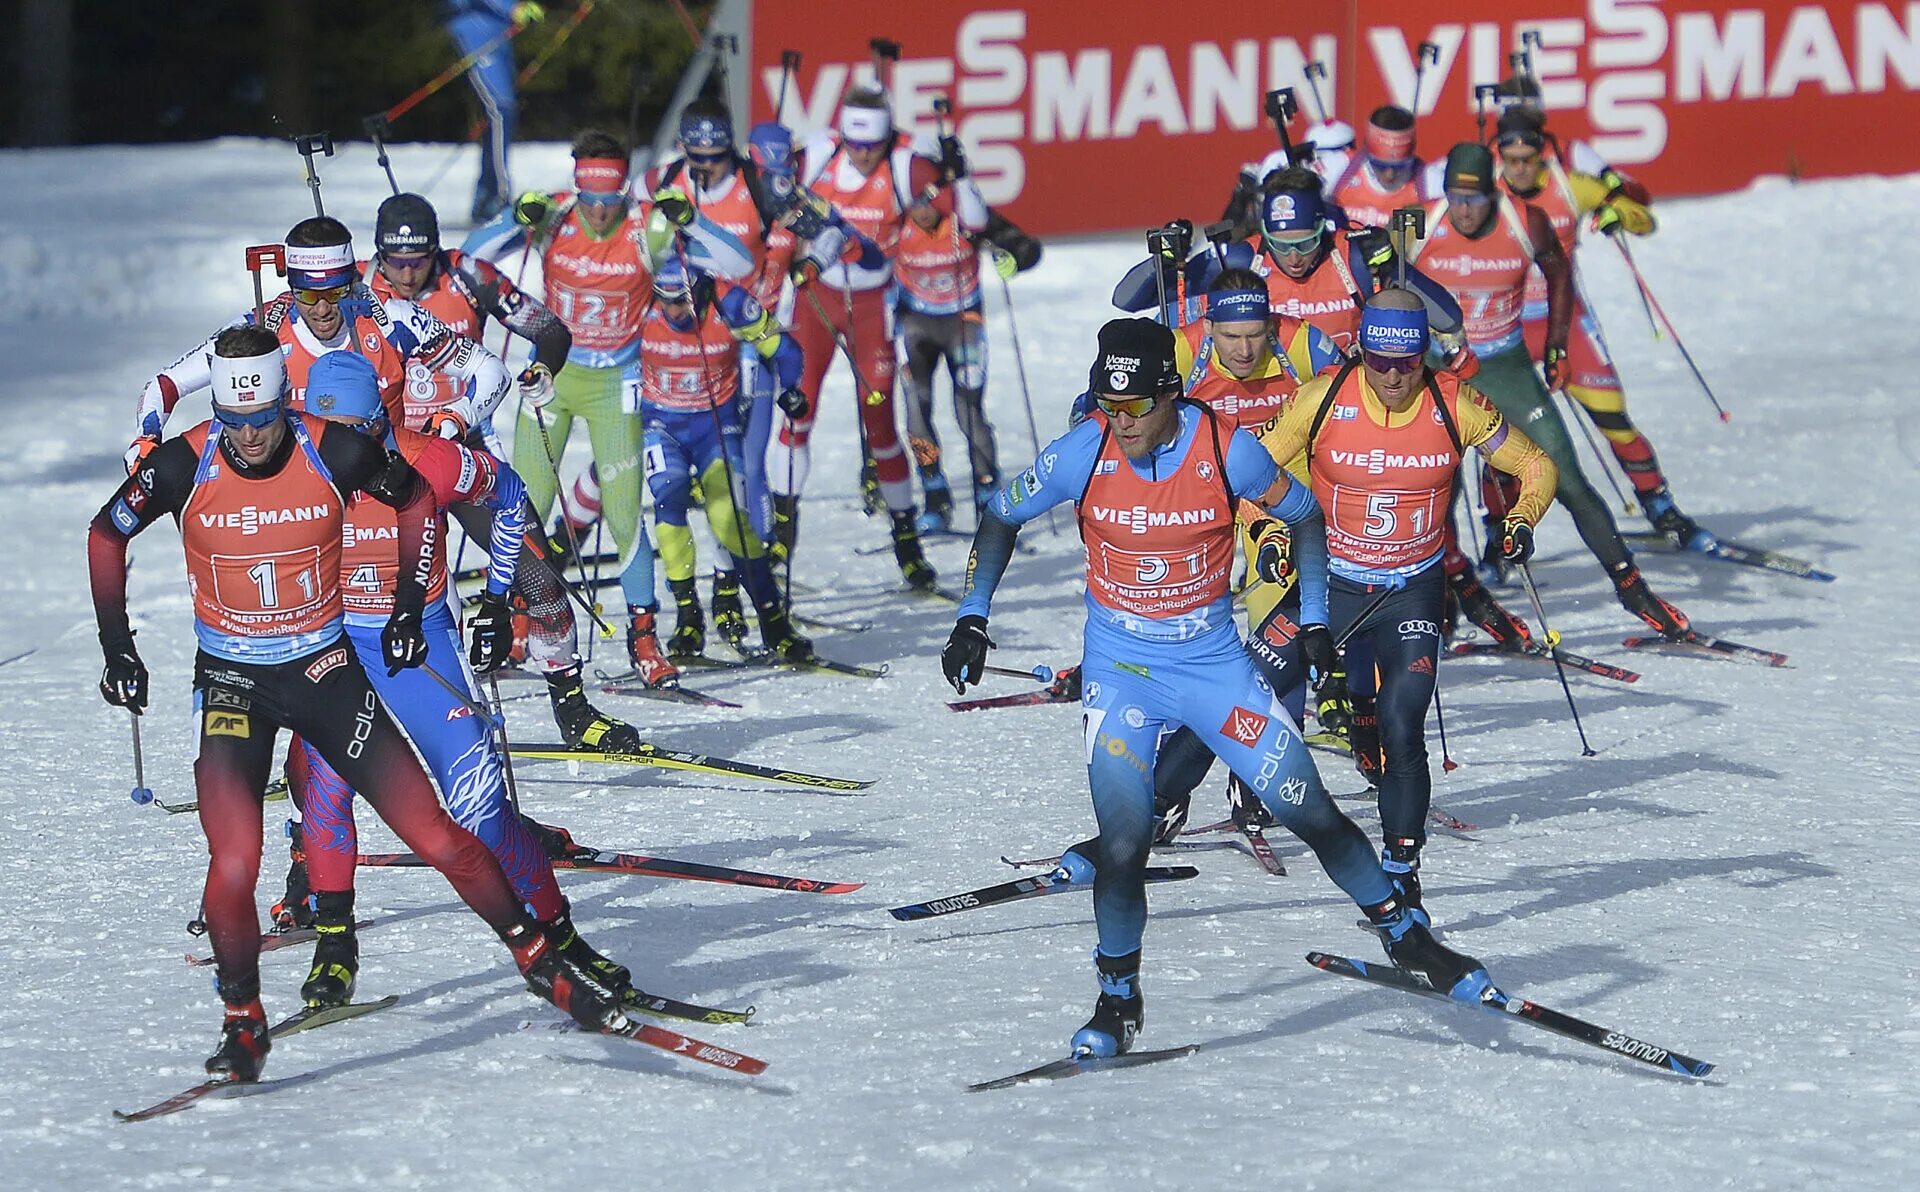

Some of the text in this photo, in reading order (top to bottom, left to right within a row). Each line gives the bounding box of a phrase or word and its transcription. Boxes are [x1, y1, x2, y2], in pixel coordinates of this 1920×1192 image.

[1367, 0, 1920, 166] VIESSMAN
[1428, 253, 1522, 277] VIESSMANN
[559, 289, 604, 327] 12
[1367, 324, 1421, 339] ERDINGER
[231, 373, 262, 390] ice
[408, 363, 436, 401] 8
[1210, 393, 1290, 415] ESSMAN
[1330, 448, 1450, 475] VIESSMANN
[199, 504, 329, 536] VIESSMANN
[1092, 505, 1216, 535] VIESSMANN
[1362, 493, 1425, 539] 5 1
[342, 522, 399, 548] SSMAN
[1382, 543, 1401, 552] NA
[415, 517, 437, 587] NORGE
[246, 559, 315, 609] 1 1
[347, 563, 381, 594] 4
[1118, 586, 1159, 598] MESTO
[1160, 587, 1181, 598] NA
[230, 613, 273, 624] MESTO
[274, 612, 294, 621] NA
[312, 651, 344, 677] MENY
[603, 754, 655, 765] FISCHER
[773, 771, 859, 790] FISCHER
[926, 894, 980, 915] salomon
[1602, 1032, 1669, 1065] salomon
